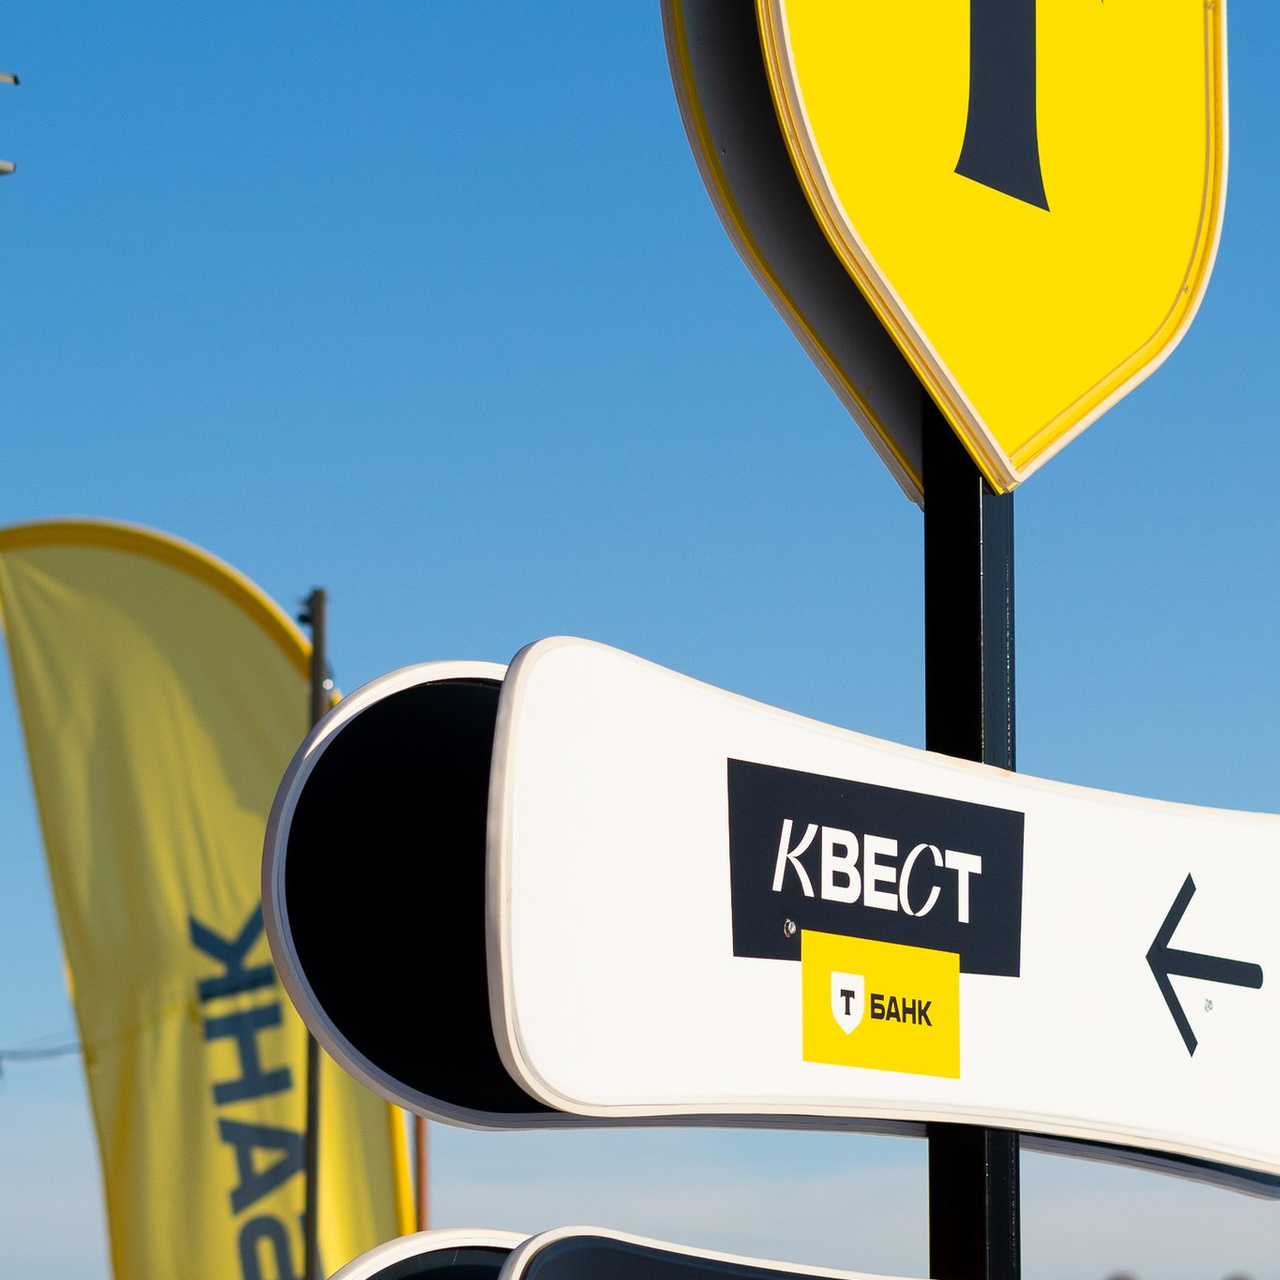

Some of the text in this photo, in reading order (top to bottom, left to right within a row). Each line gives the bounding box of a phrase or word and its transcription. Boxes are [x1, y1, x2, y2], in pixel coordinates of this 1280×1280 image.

[771, 818, 983, 924] КВЕСТ
[839, 988, 933, 1027] Т БАНК
